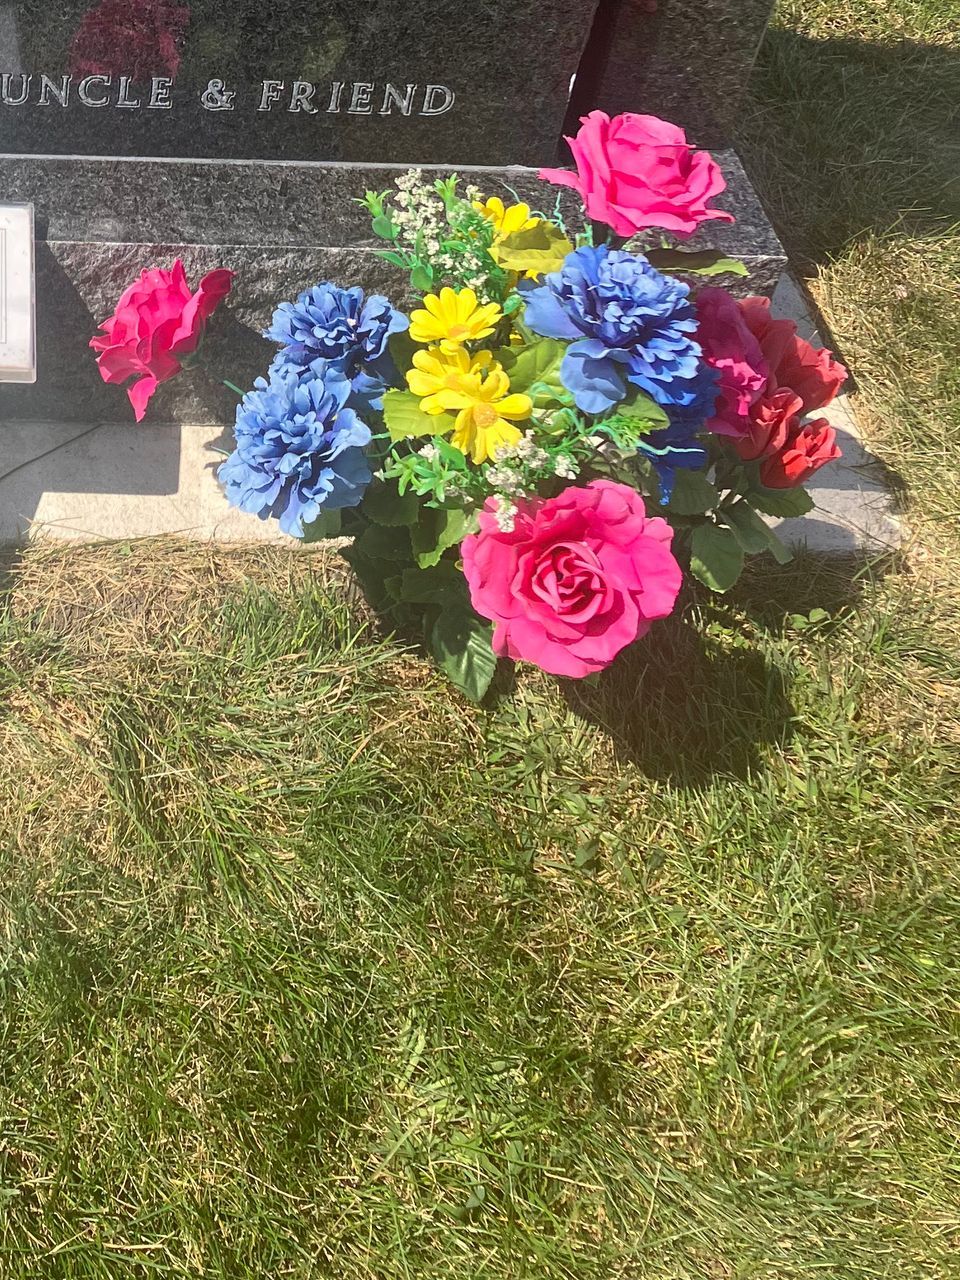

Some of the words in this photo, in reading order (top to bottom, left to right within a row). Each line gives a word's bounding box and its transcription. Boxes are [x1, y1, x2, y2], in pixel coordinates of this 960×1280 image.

[0, 72, 175, 110] UNCLE
[200, 78, 236, 112] &
[257, 78, 456, 117] FRIEND
